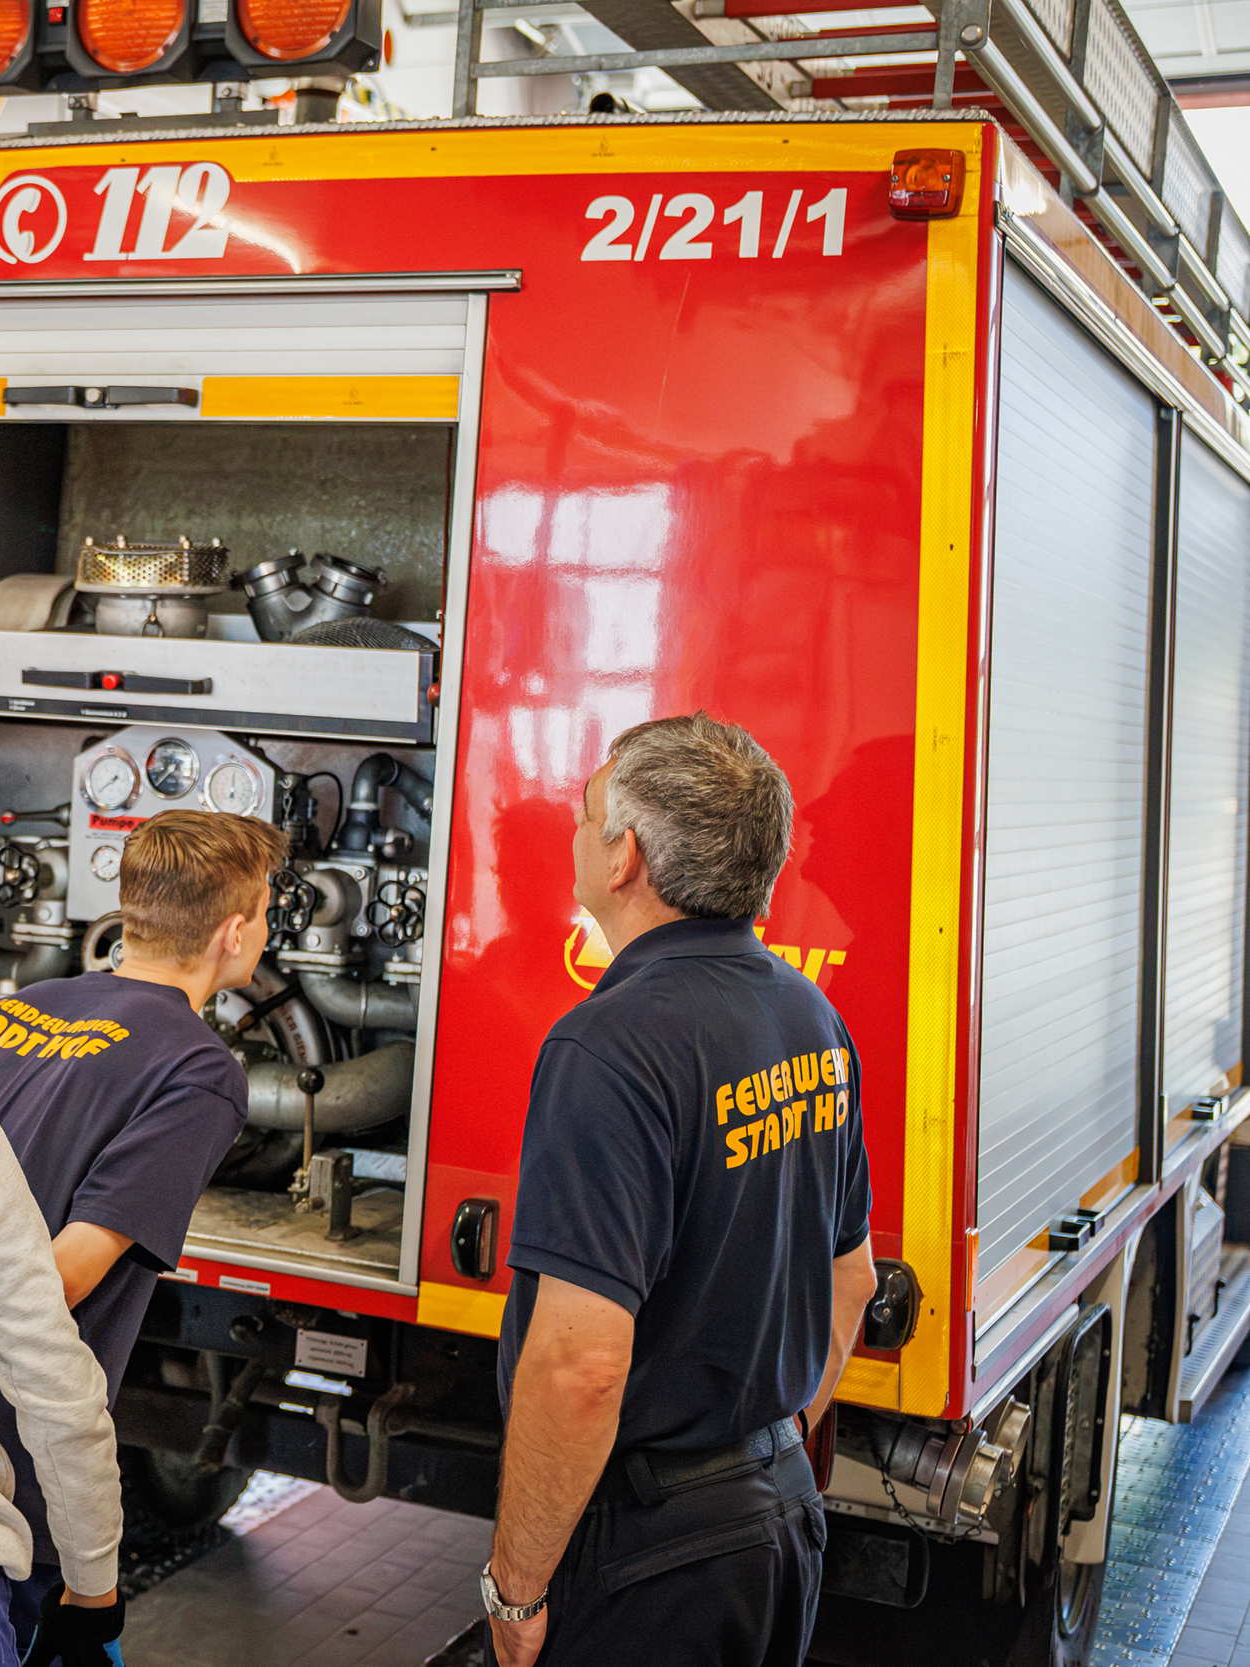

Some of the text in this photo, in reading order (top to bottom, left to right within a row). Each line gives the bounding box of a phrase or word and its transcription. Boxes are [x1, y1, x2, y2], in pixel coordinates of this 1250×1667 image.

[83, 161, 231, 261] 112
[580, 187, 848, 262] 2/21/1
[92, 815, 134, 830] Pumpe
[36, 1034, 111, 1061] HOF
[715, 1046, 851, 1126] FEUERWEHR
[724, 1088, 850, 1170] STADT HO
